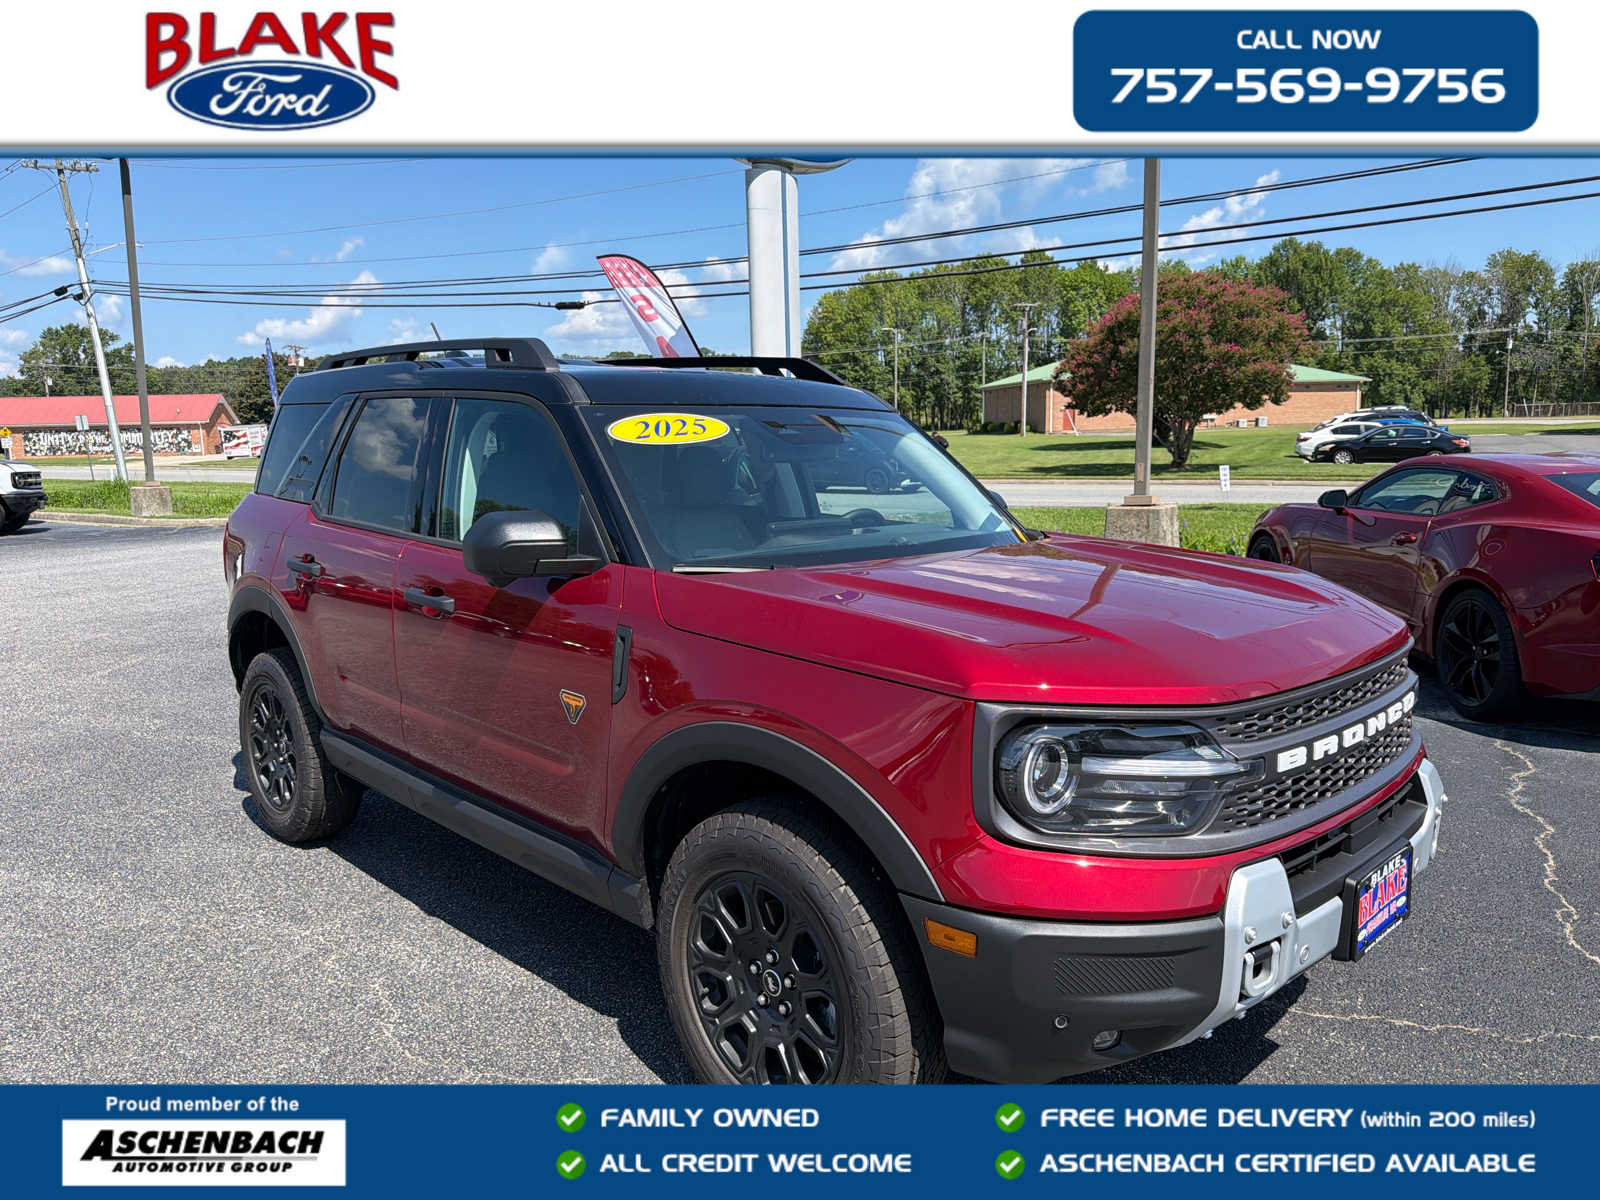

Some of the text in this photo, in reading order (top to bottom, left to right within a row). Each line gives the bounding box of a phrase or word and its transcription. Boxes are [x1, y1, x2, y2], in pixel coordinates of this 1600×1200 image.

[634, 418, 707, 440] 2025
[1277, 691, 1415, 773] BRONCO
[1371, 855, 1402, 888] BLAKE
[1358, 865, 1408, 928] BLAKE
